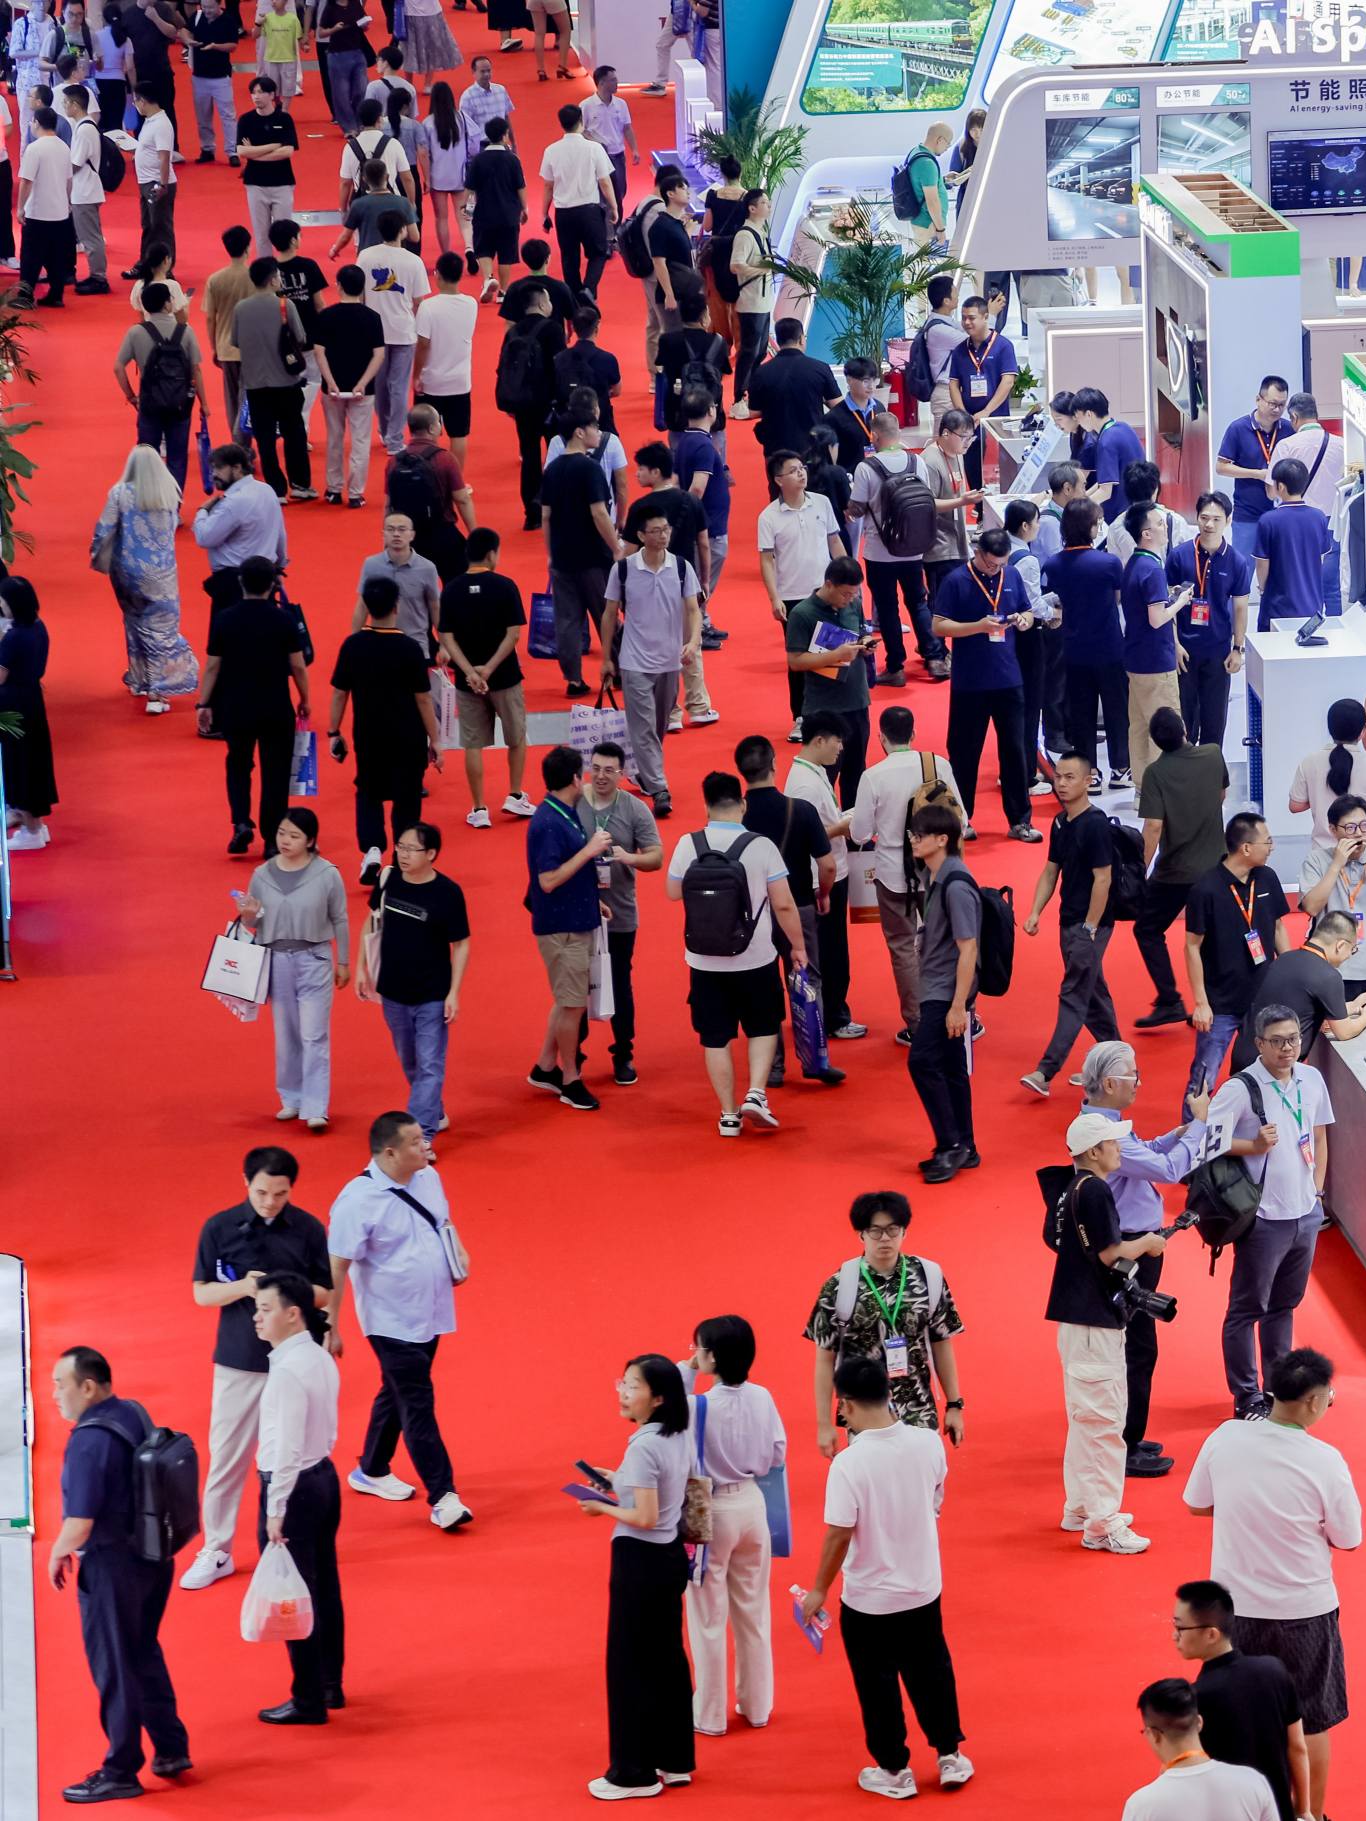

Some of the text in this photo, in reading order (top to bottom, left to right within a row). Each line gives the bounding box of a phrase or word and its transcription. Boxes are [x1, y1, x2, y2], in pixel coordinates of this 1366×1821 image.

[1249, 18, 1296, 55] AI
[1301, 102, 1363, 113] energy-saving
[1078, 1223, 1091, 1247] Canon
